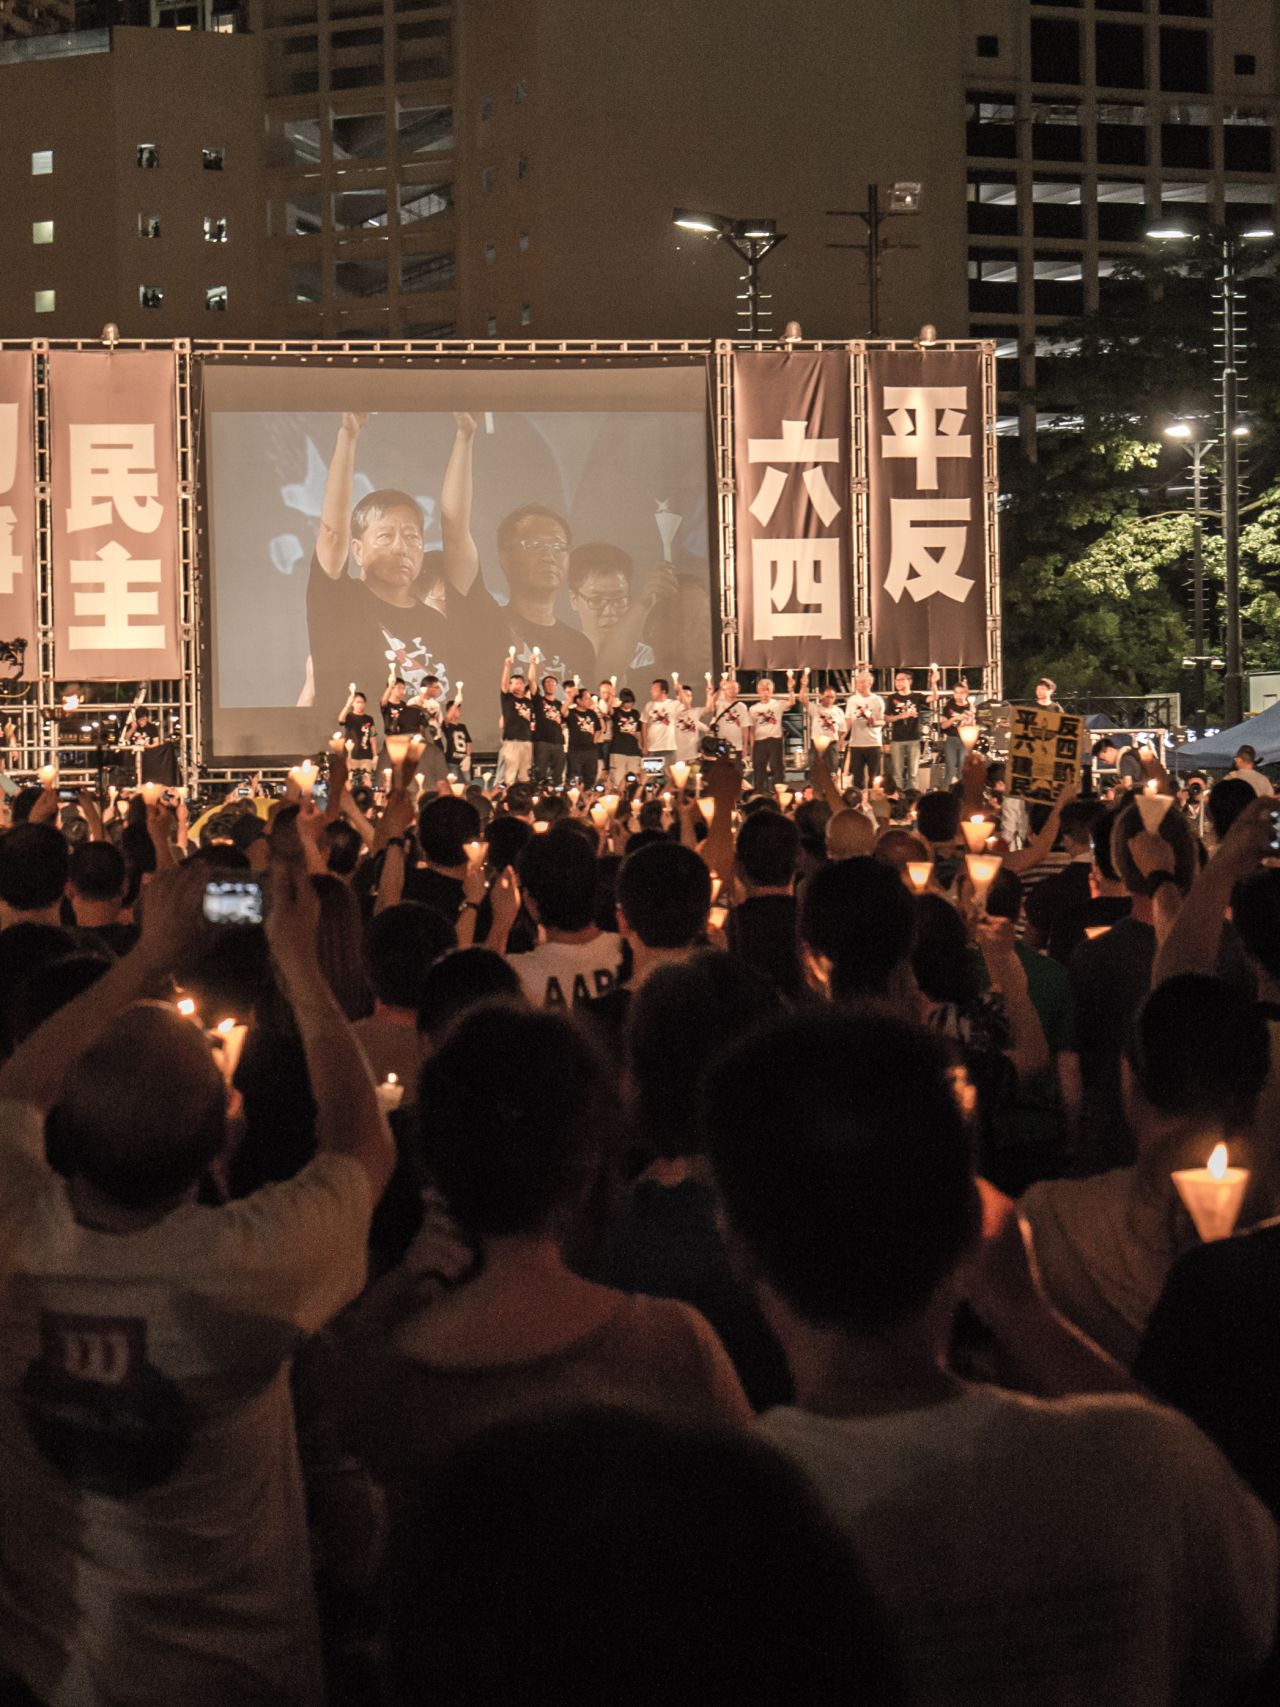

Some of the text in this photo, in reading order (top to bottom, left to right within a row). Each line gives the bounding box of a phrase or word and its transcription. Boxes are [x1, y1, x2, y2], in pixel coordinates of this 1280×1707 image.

[66, 423, 166, 649] 民主
[748, 420, 841, 640] 六四
[881, 386, 976, 604] 平反
